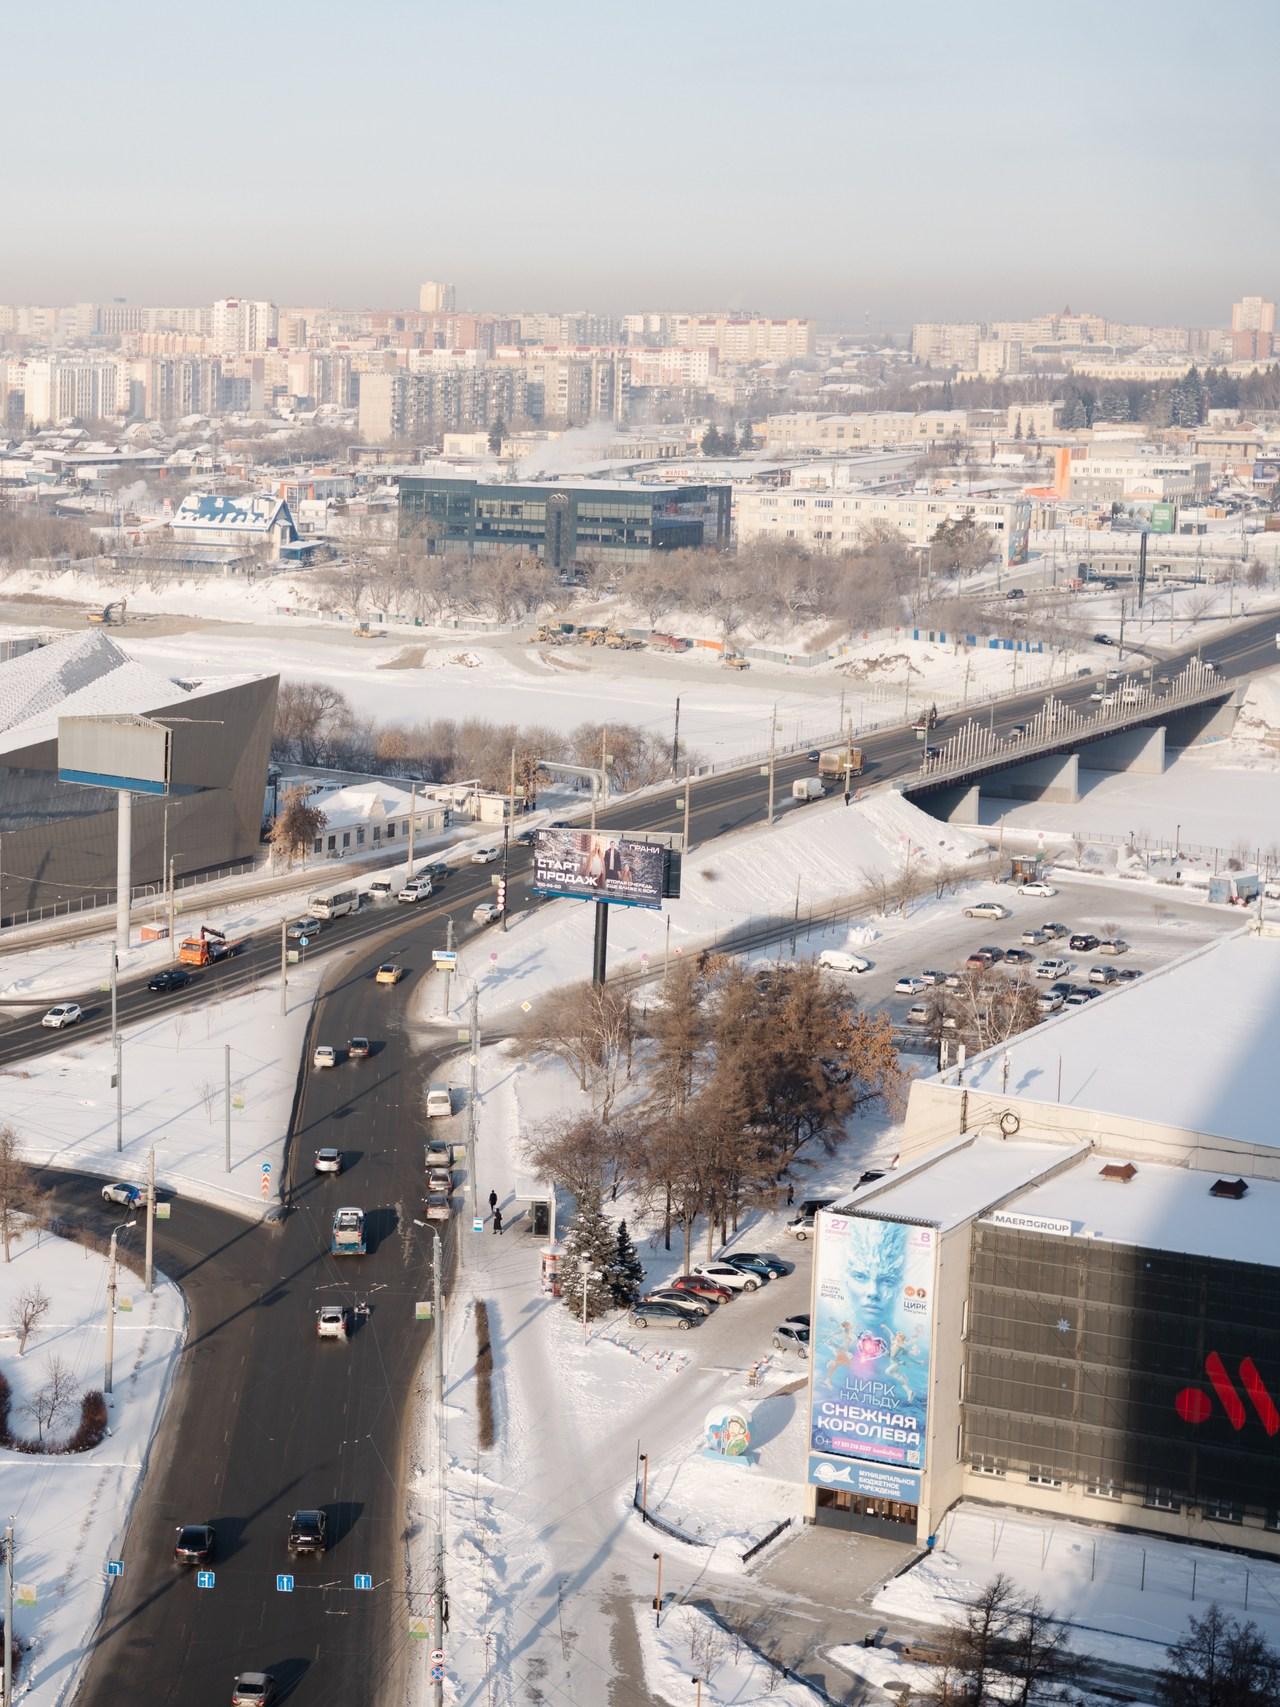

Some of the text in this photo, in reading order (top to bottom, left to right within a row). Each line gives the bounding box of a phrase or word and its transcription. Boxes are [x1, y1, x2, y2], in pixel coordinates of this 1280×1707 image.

[630, 844, 660, 854] ГРАНИ
[538, 859, 580, 871] СТАРТ
[537, 870, 598, 886] ПРОДАЖ
[831, 1219, 848, 1230] 27
[920, 1232, 931, 1243] 8
[904, 1301, 927, 1311] ЦИРК
[846, 1377, 896, 1397] ЦИРК
[840, 1390, 900, 1409] НА ЛЬДУ
[822, 1402, 917, 1430] СНЕЖНАЯ
[817, 1416, 920, 1445] КОРОЛЕВА
[815, 1435, 830, 1445] 0+
[859, 1470, 916, 1486] МУНИЦИПАЛЬНОЕ
[859, 1477, 900, 1489] БЮДЖЕТНОЕ
[859, 1484, 901, 1497] УЧРЕЖДЕНИЕ
